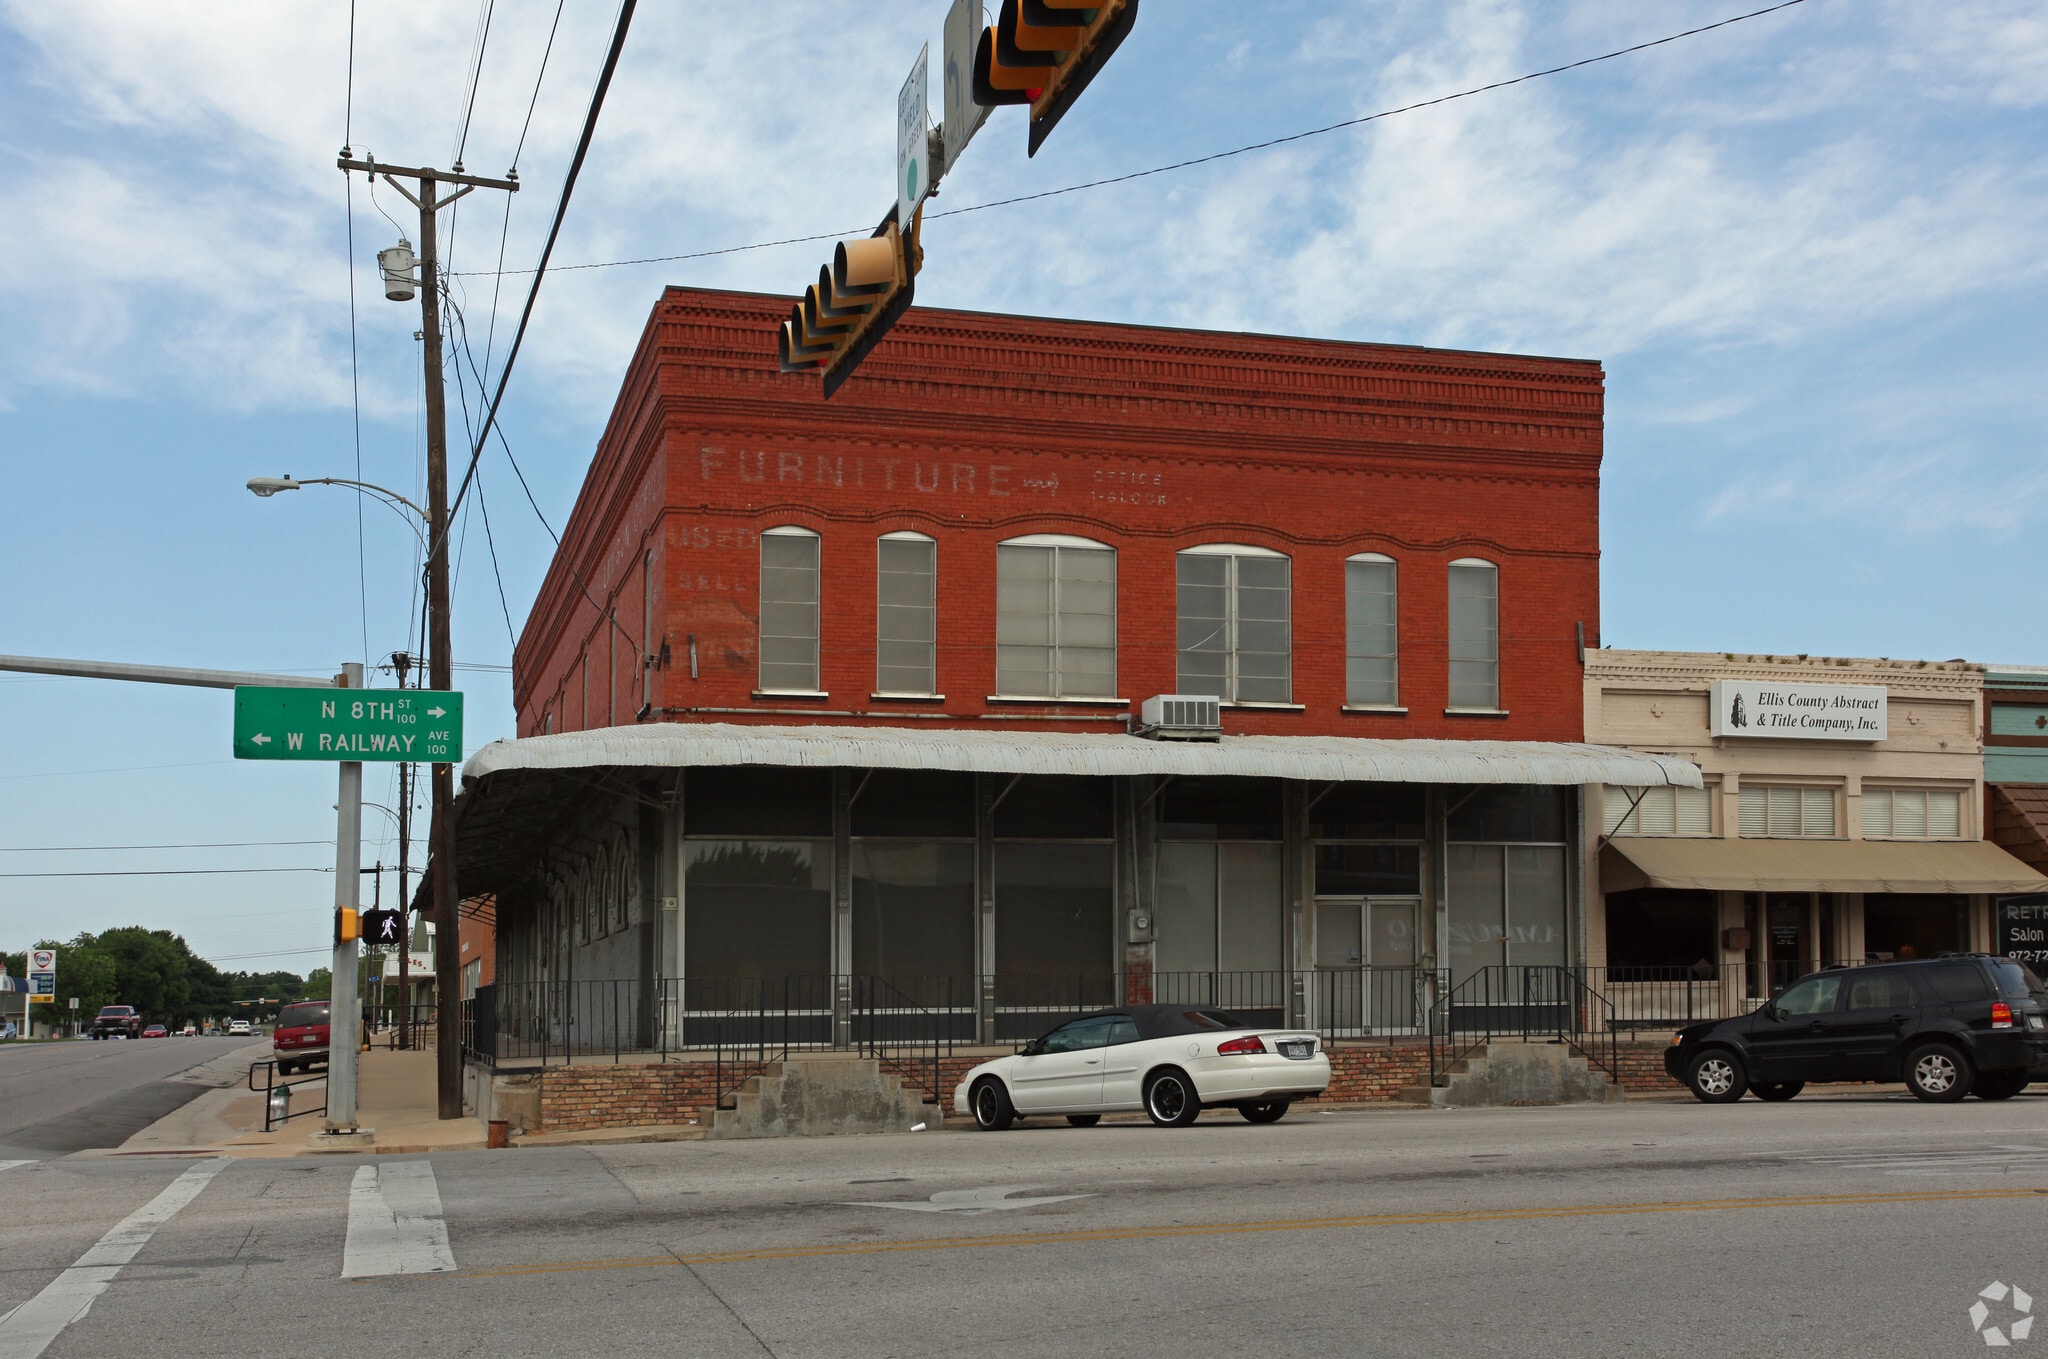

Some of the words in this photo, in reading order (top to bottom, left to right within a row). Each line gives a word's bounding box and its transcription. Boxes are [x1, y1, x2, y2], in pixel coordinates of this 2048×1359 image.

[904, 92, 920, 137] YIELD
[909, 117, 923, 154] GREEN
[700, 446, 1014, 497] FURNITURE
[321, 700, 336, 719] N
[351, 701, 394, 720] 8TH
[398, 699, 411, 709] ST
[1757, 692, 1784, 706] Ellis
[1787, 693, 1828, 711] County
[1830, 695, 1879, 710] Abstract
[397, 714, 416, 724] 100
[1757, 712, 1766, 726] &
[1770, 713, 1797, 728] Title
[1800, 714, 1854, 732] Company,
[1857, 716, 1879, 730] Inc.
[287, 733, 304, 750] W
[319, 733, 416, 753] RAILWAY
[428, 731, 450, 741] AVE
[427, 744, 447, 755] 100
[2010, 927, 2044, 942] Salon
